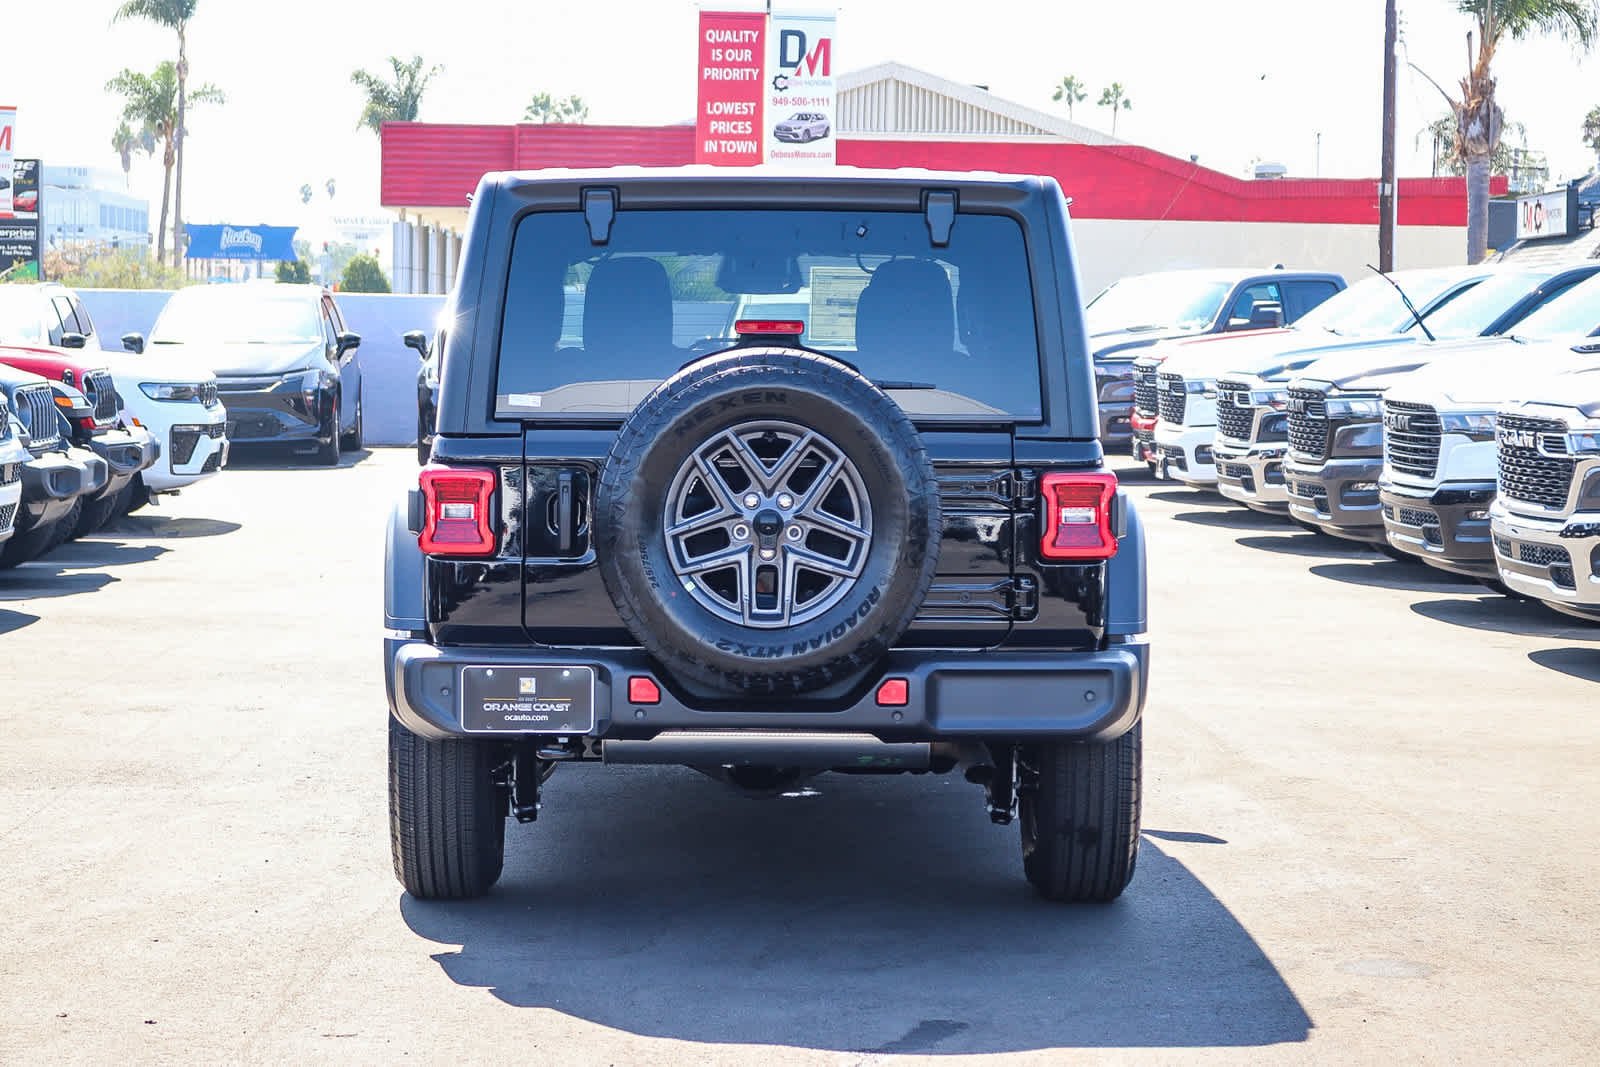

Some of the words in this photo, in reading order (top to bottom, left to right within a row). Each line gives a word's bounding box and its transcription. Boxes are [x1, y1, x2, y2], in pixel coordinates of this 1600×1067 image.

[705, 30, 759, 43] QUALITY
[712, 49, 723, 62] IS
[725, 49, 752, 62] OUR
[703, 67, 760, 81] PRIORITY
[706, 102, 756, 115] LOWEST
[710, 121, 752, 134] PRICES
[705, 140, 718, 153] IN
[721, 140, 757, 153] TOWN
[674, 391, 787, 435] NEXEN
[791, 586, 881, 655] ROADIAN
[483, 703, 532, 712] ORANGE
[533, 703, 570, 712] COAST
